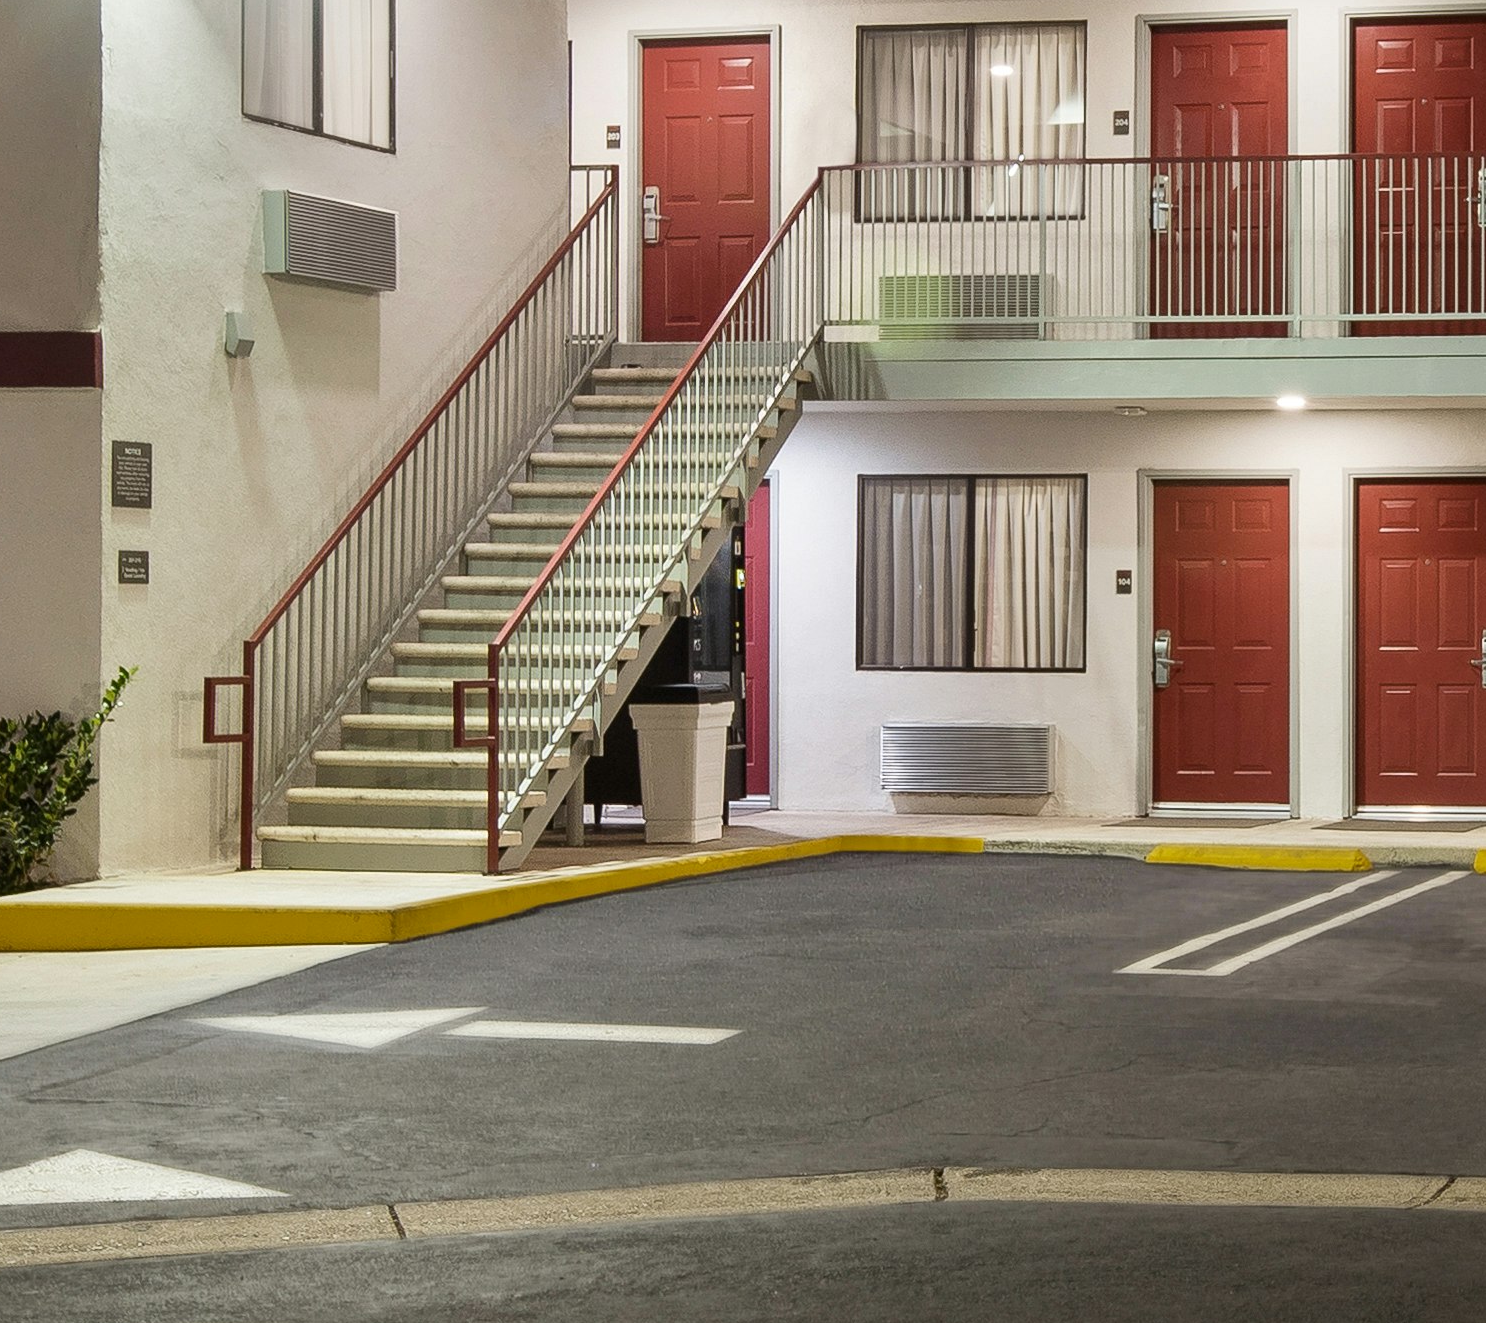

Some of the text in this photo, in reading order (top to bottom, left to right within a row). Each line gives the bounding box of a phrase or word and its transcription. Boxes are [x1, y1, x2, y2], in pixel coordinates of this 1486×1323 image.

[1115, 118, 1129, 127] 204
[607, 132, 620, 141] 203
[1117, 578, 1131, 586] 104
